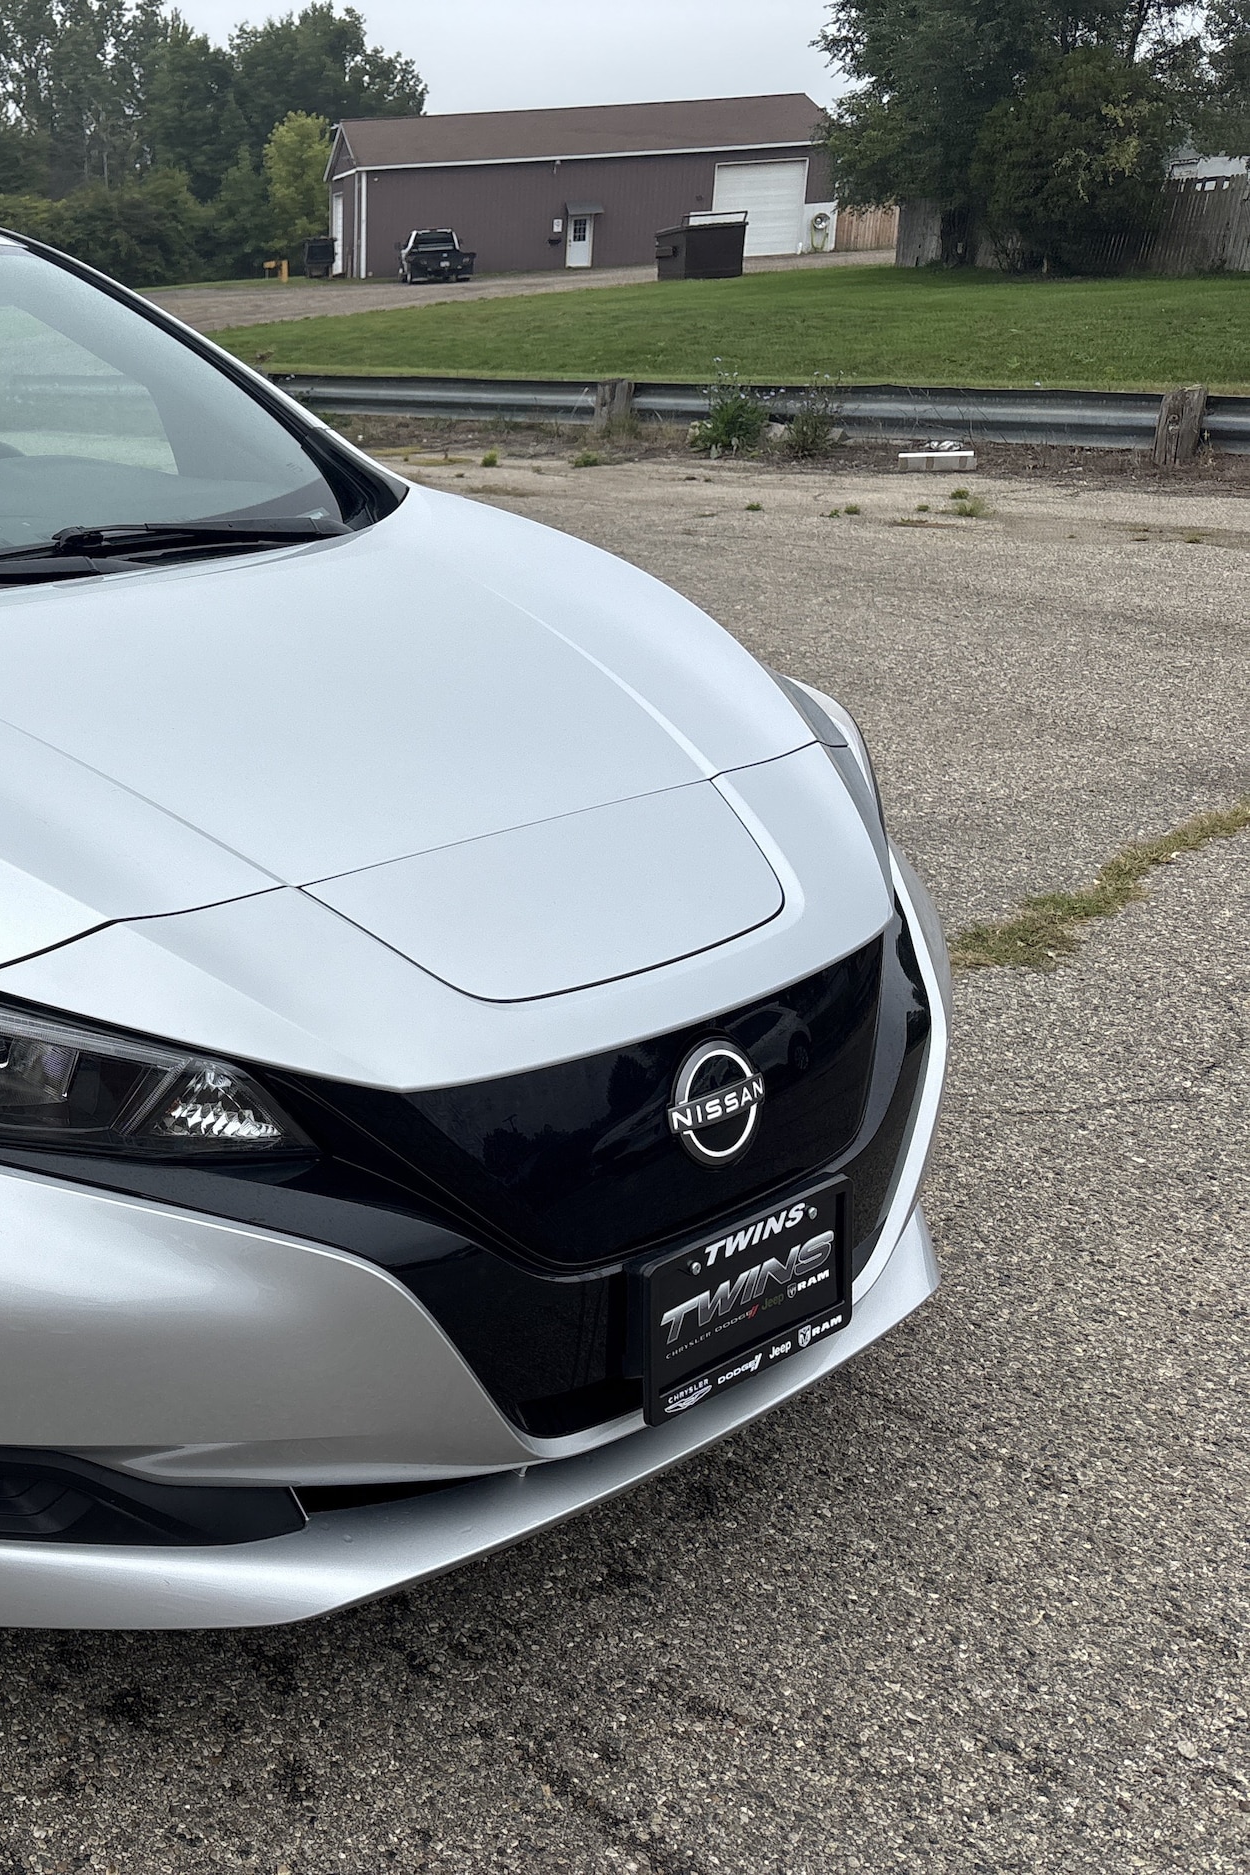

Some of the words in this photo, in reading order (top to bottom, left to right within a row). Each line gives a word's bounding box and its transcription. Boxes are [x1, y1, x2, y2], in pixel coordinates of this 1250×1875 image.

[671, 1077, 764, 1131] NISSAN
[704, 1202, 806, 1267] TWINS
[659, 1230, 835, 1345] TWINS
[665, 1332, 712, 1360] CHRYSLER
[714, 1310, 754, 1333] DODGE
[761, 1293, 785, 1311] Jeep
[797, 1269, 830, 1292] RAM
[668, 1378, 709, 1404] CHRYSLER
[717, 1359, 756, 1385] DODGE
[769, 1340, 792, 1359] Jeep
[811, 1314, 843, 1337] RAM
